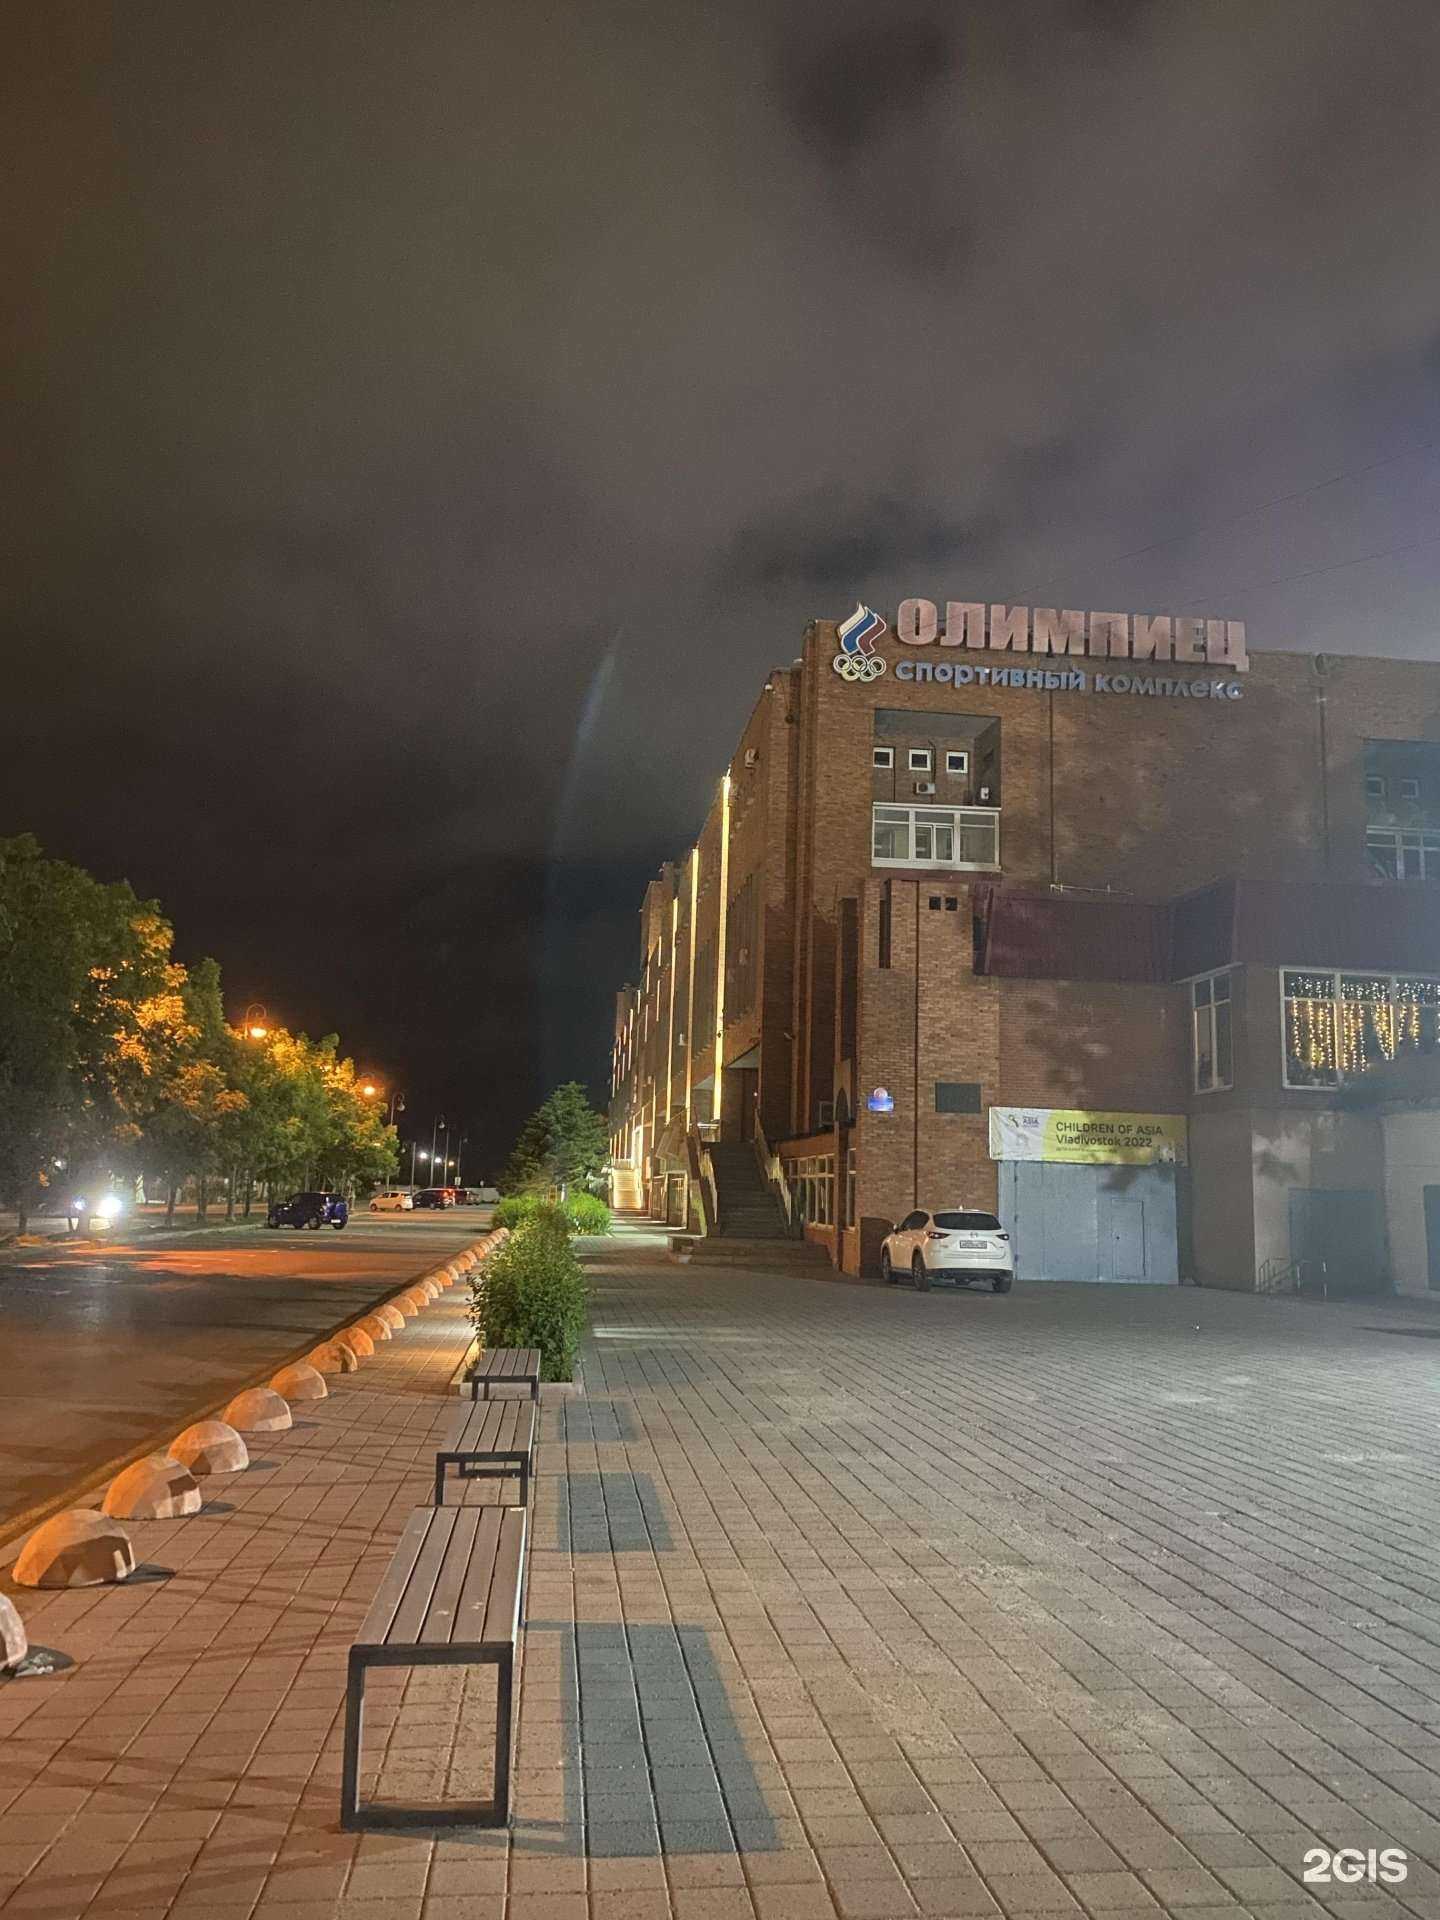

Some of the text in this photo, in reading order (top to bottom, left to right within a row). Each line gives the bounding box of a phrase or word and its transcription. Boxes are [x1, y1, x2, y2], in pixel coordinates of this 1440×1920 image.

[898, 598, 1249, 672] ОЛИМПИЕЦ
[1056, 1121, 1163, 1135] CHILDREN OF ASIA
[1056, 1135, 1153, 1148] Vladivostok 2022
